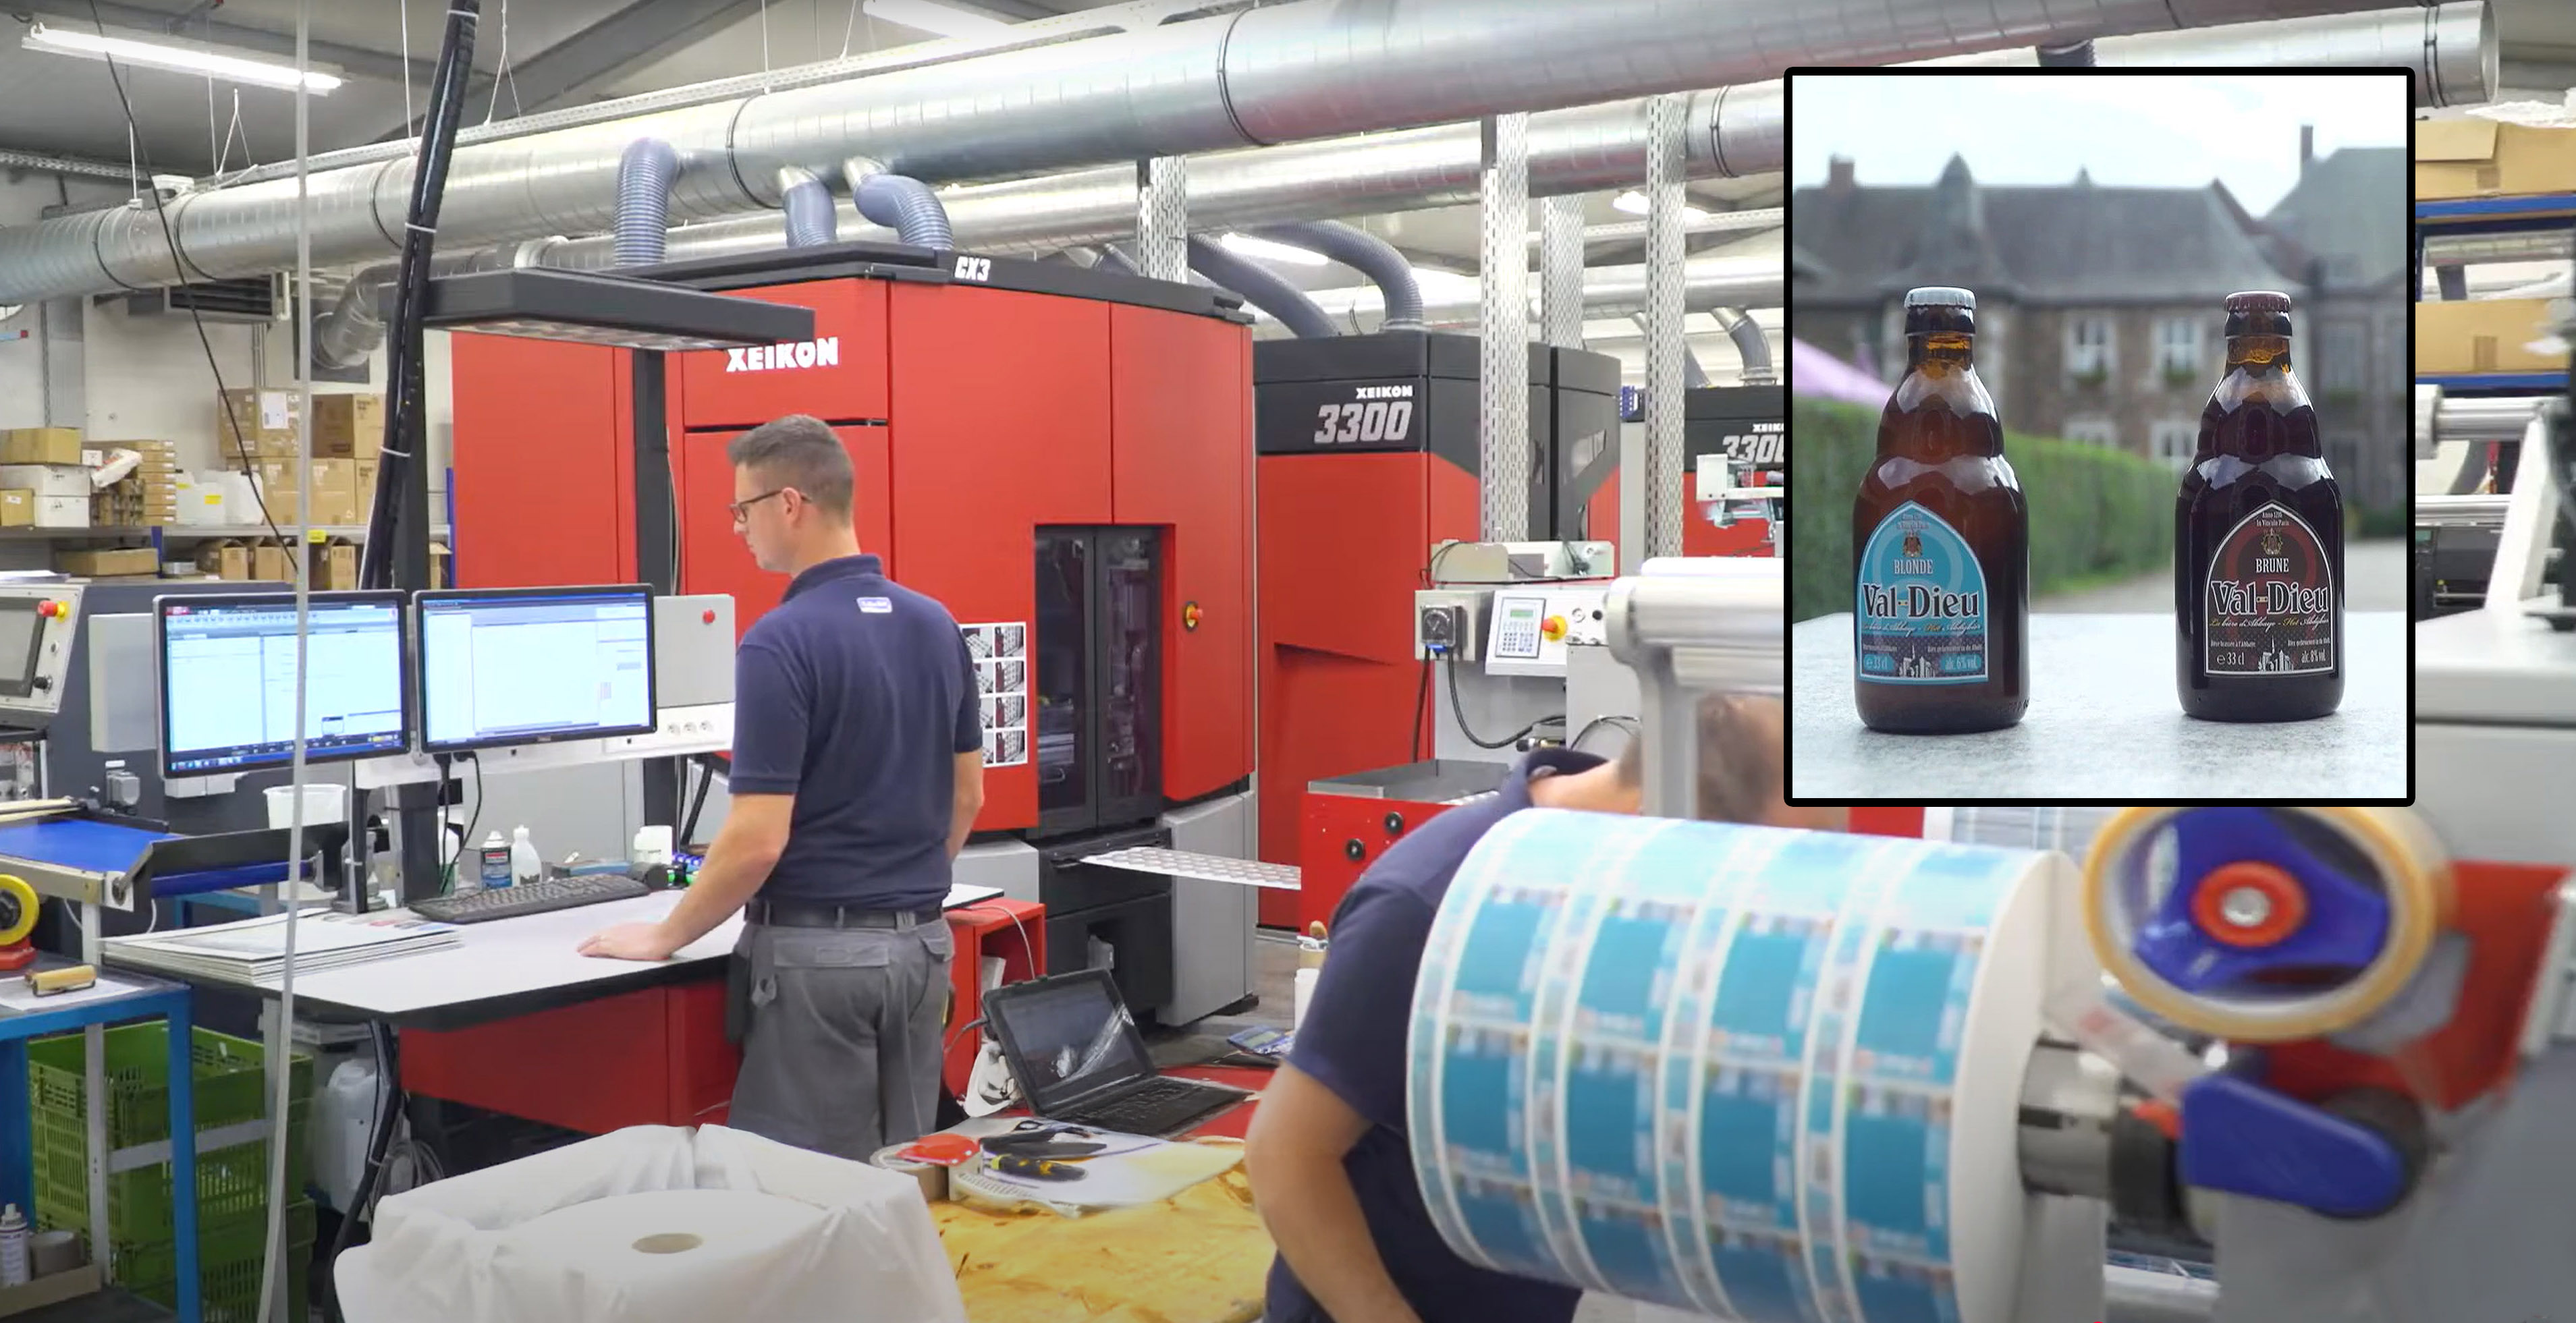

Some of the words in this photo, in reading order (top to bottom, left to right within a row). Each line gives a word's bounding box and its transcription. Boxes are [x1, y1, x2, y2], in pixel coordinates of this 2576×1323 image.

[954, 256, 991, 281] CX3
[725, 337, 839, 372] XEIKON
[1356, 385, 1413, 399] XEIKON
[1314, 401, 1413, 444] 3300
[1894, 559, 1933, 574] BLONDE
[2255, 558, 2289, 573] BRUNE
[2226, 652, 2236, 665] 33
[2238, 652, 2245, 665] cl
